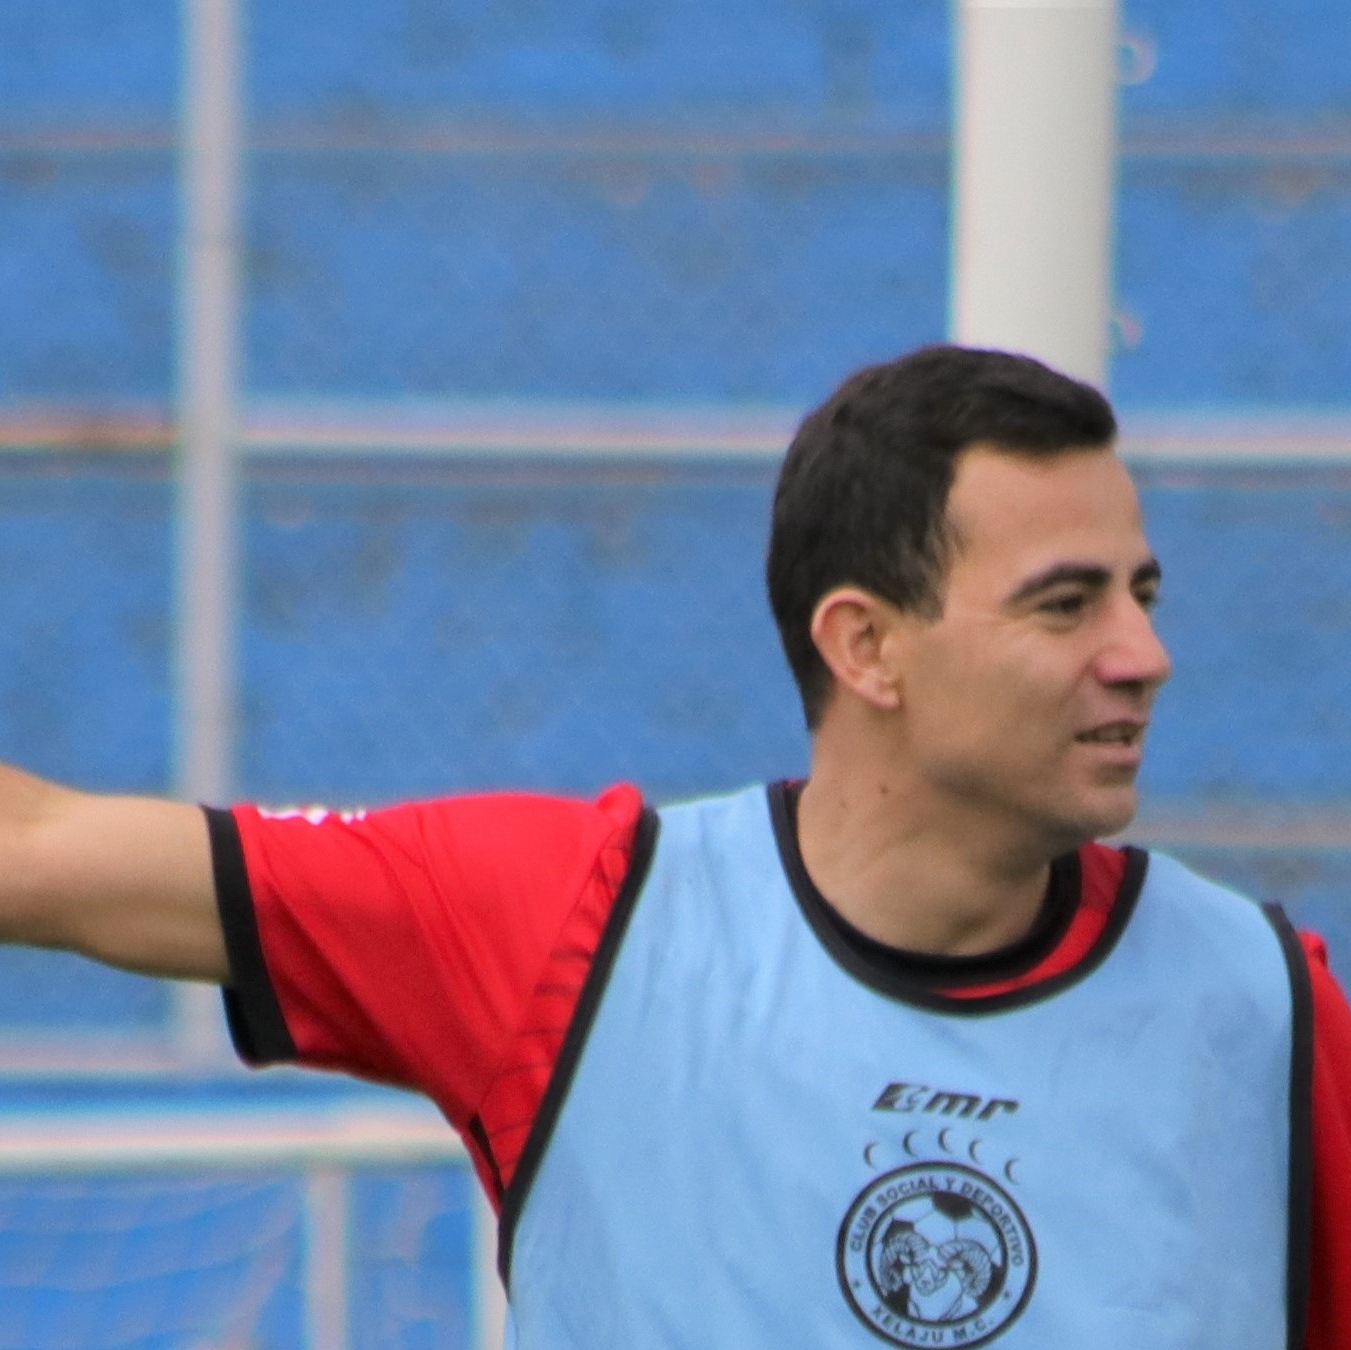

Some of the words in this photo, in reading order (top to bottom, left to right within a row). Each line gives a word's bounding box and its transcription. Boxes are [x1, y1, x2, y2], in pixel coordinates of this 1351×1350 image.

[849, 1206, 877, 1252] CLUB
[876, 1175, 939, 1207] SOCIAL
[945, 1175, 956, 1190] Y
[960, 1181, 1024, 1267] DEPORTIVO
